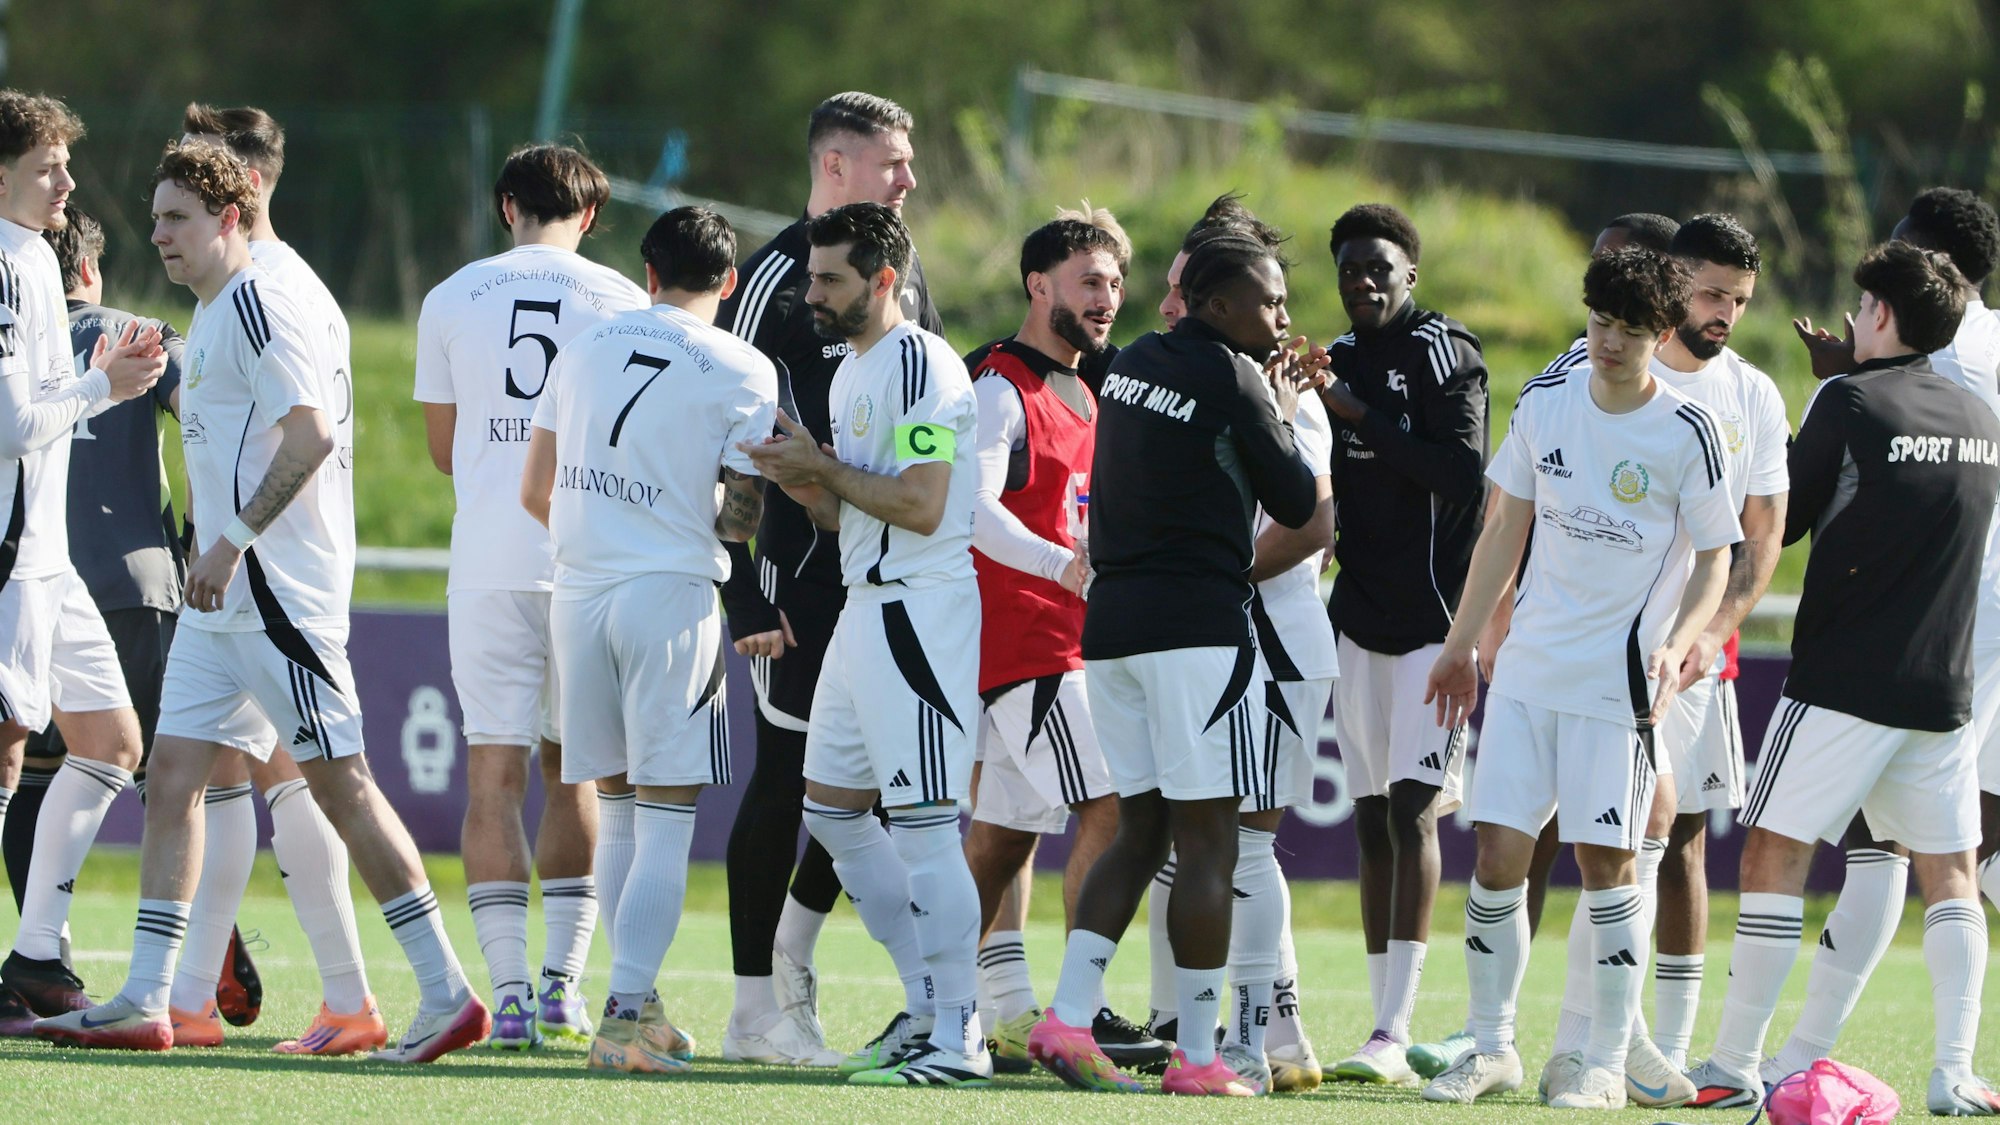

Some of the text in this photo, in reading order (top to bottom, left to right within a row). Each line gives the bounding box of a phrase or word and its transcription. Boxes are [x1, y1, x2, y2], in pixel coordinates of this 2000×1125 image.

[470, 269, 606, 312] BCV GLESCH/PAFFENDORF
[505, 299, 561, 400] 5
[609, 350, 671, 447] 7
[1100, 373, 1197, 422] SPORT MILA
[908, 424, 936, 455] C
[1887, 435, 1999, 467] SPORT MILA
[559, 465, 663, 509] MANOLOV
[1238, 984, 1251, 1046] OOTBALLSOCKS
